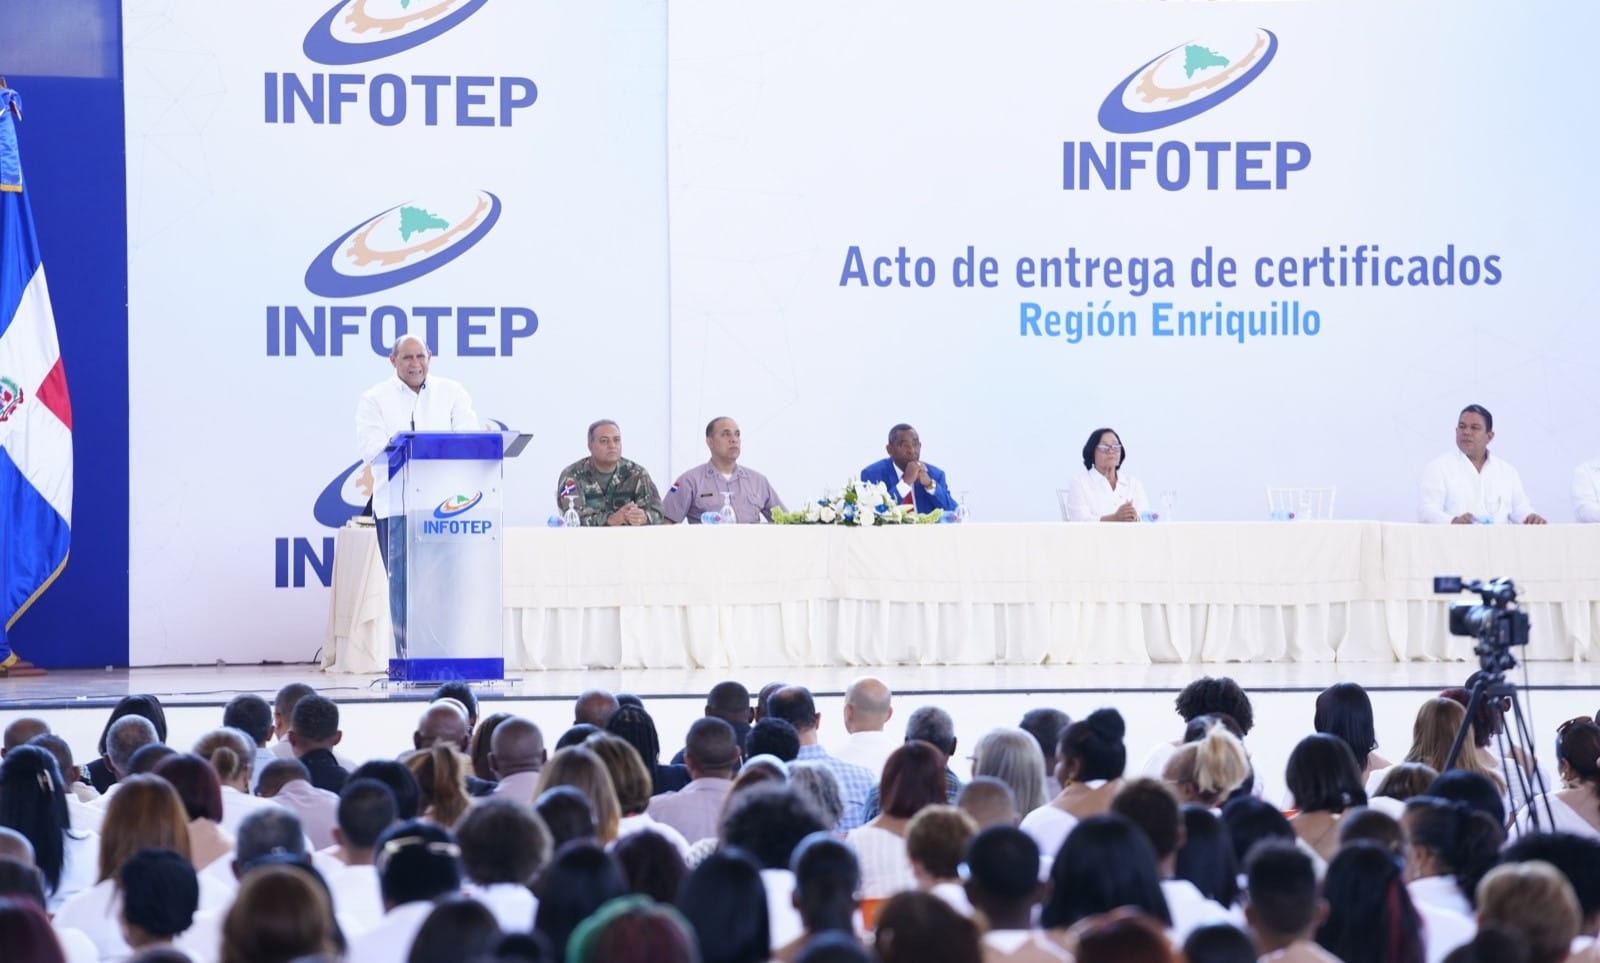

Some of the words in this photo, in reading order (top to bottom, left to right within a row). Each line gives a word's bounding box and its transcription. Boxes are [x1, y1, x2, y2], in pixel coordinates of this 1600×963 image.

[264, 72, 537, 126] INFOTEP
[1063, 141, 1311, 191] INFOTEP
[840, 246, 935, 287] Acto
[953, 246, 998, 288] de
[1016, 248, 1174, 296] entrega
[1191, 246, 1236, 288] de
[1255, 244, 1502, 288] certificados
[266, 305, 538, 357] INFOTEP
[1020, 300, 1136, 344] Región
[1152, 300, 1320, 344] Enriquillo
[423, 520, 492, 535] INFOTEP
